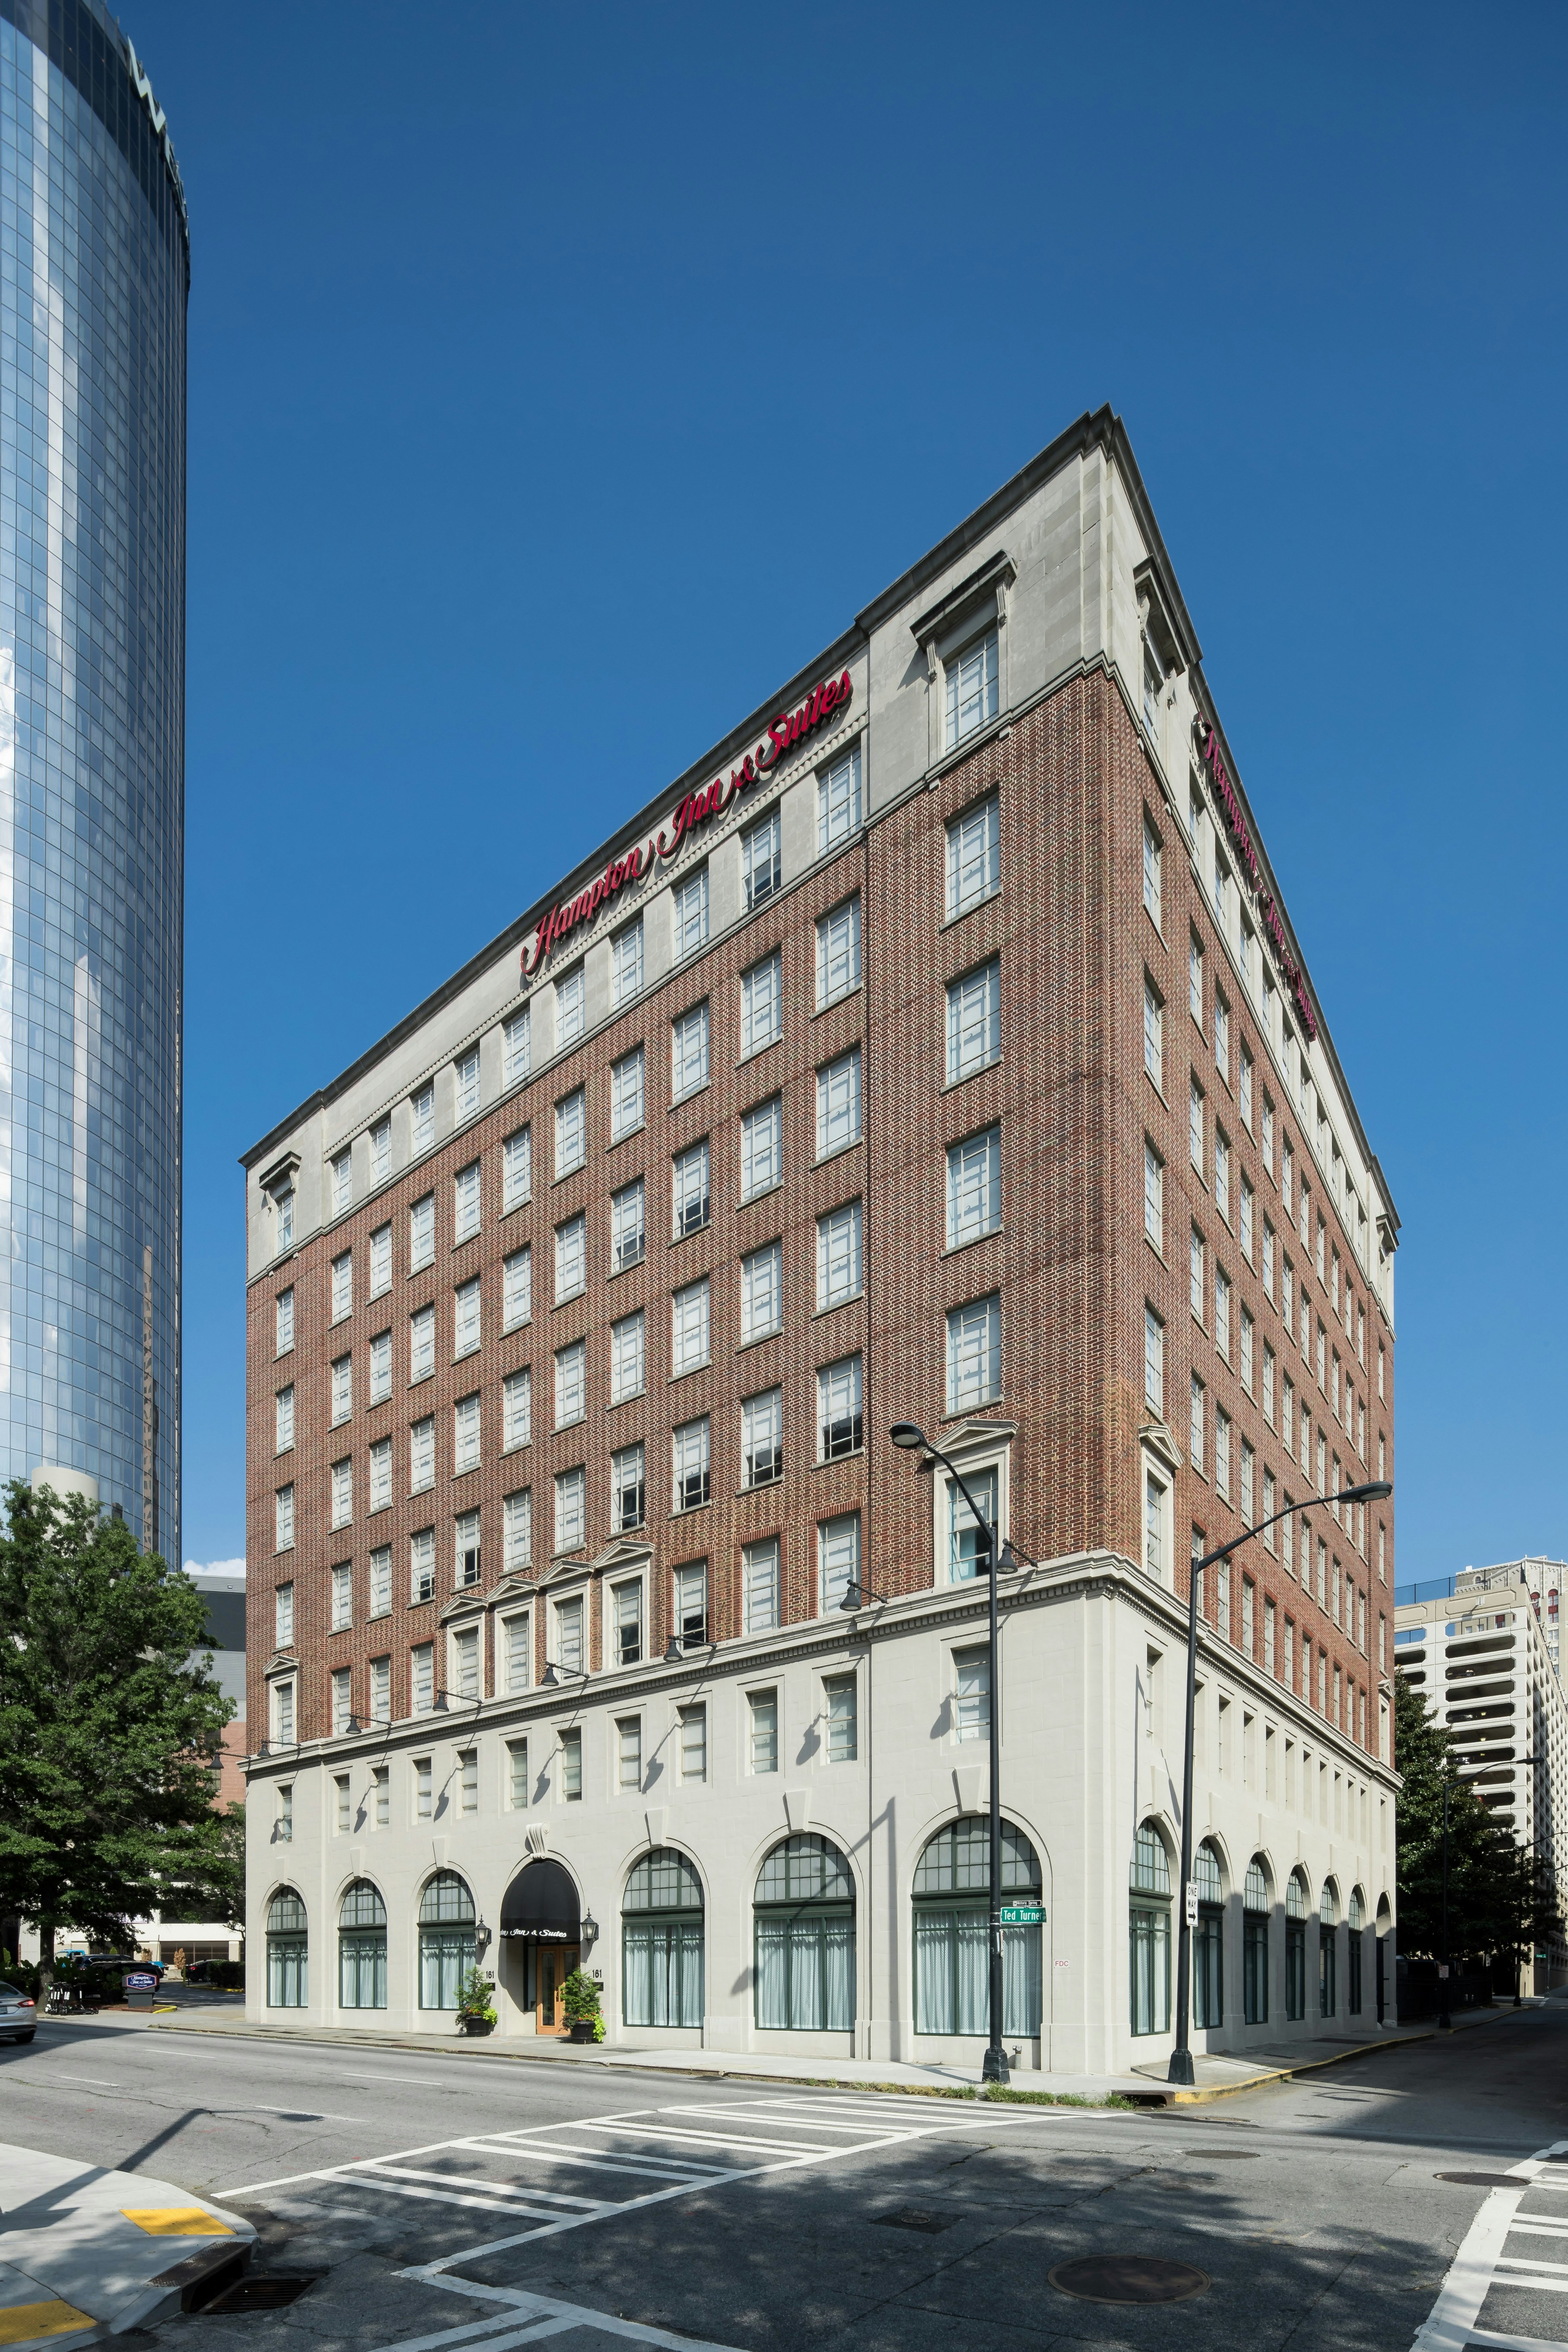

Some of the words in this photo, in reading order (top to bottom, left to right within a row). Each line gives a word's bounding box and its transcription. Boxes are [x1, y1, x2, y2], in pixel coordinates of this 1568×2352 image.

[520, 840, 654, 976] Hampton
[656, 770, 736, 858] Inn
[735, 755, 757, 789] &
[754, 670, 852, 771] Suites
[1188, 1886, 1197, 1897] ONE
[1187, 1899, 1196, 1909] WAY
[1004, 1910, 1016, 1920] Ted
[1020, 1910, 1042, 1920] Turner
[539, 1929, 567, 1938] Suites
[486, 1970, 494, 1979] 161
[592, 1969, 602, 1978] 161
